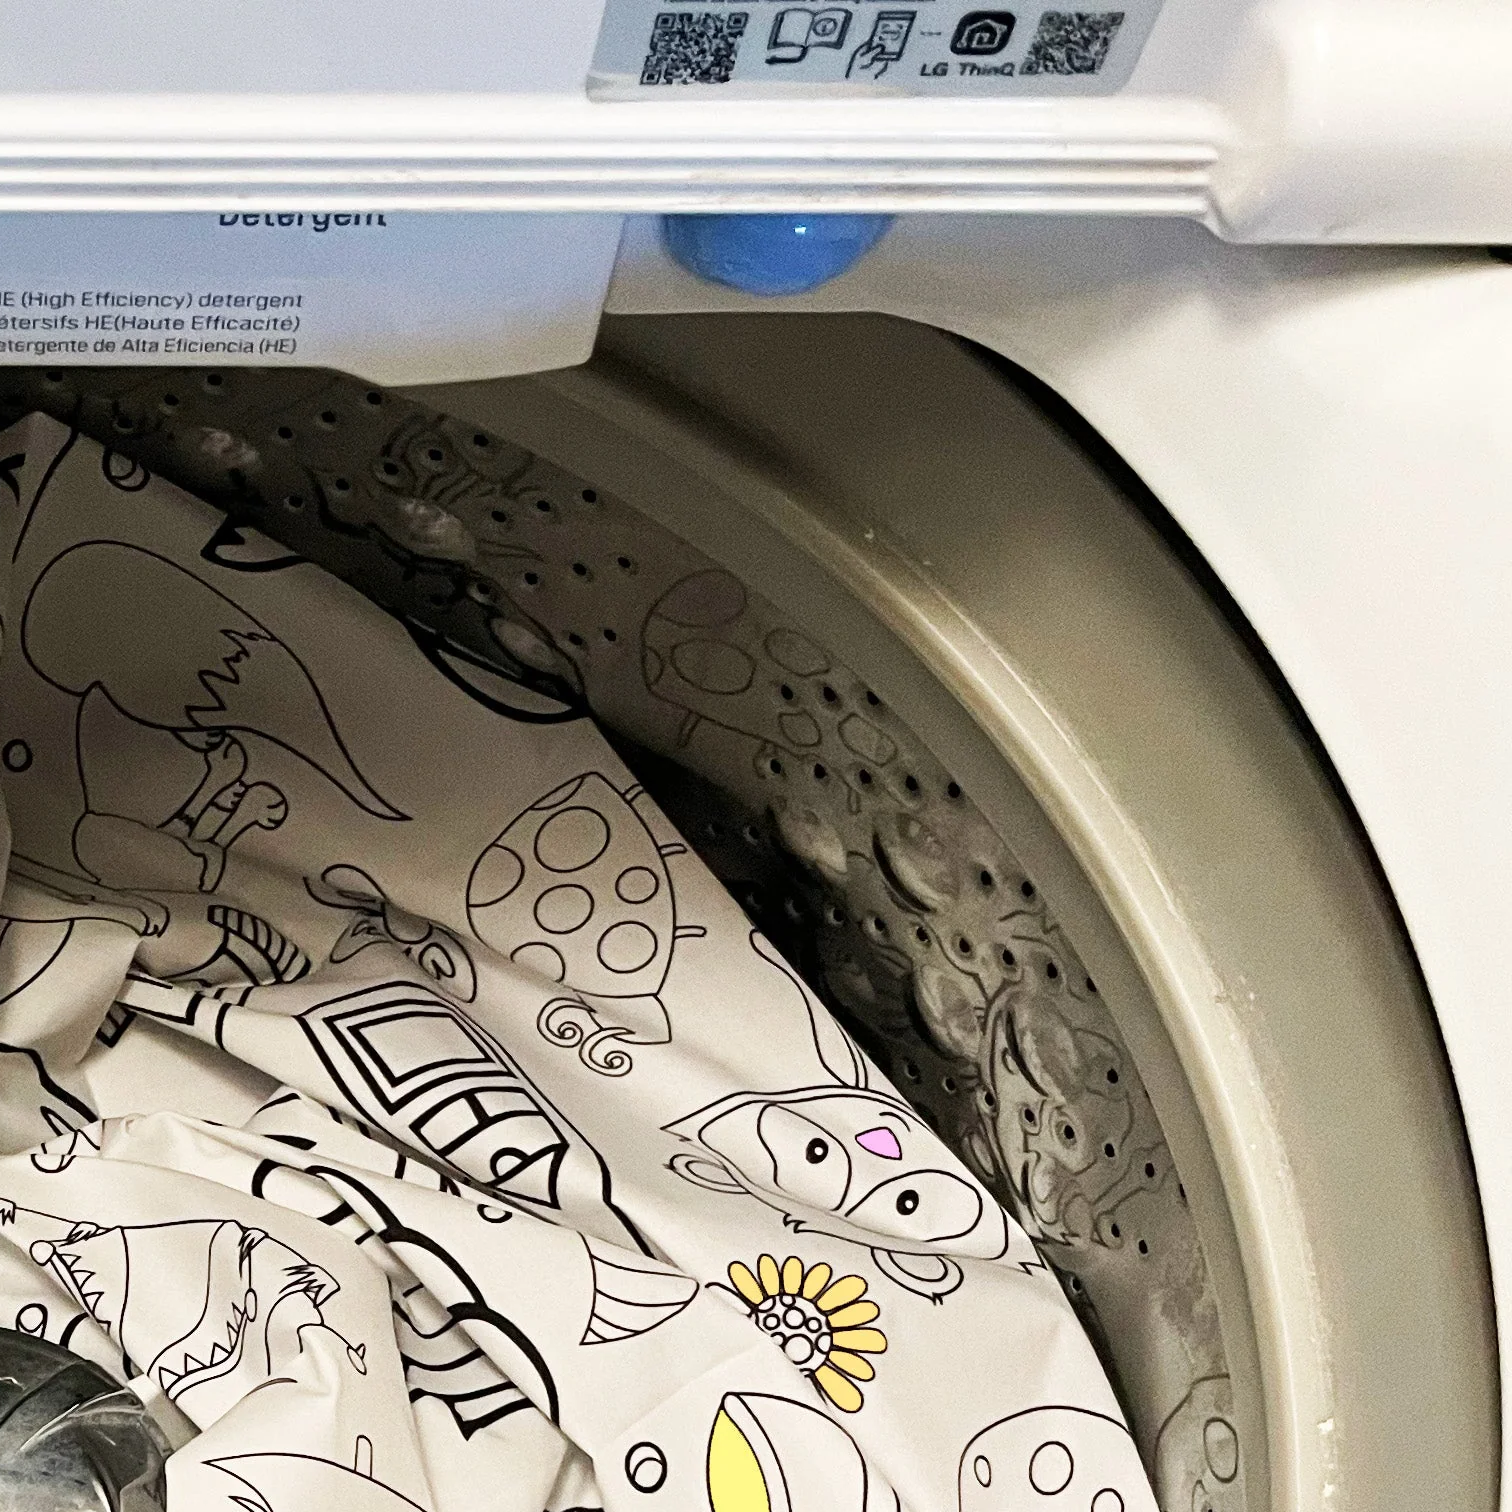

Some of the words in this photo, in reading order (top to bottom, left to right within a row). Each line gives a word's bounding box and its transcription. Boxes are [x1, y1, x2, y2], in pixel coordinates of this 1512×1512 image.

[920, 63, 948, 77] LG
[959, 63, 1014, 77] ThinQ
[21, 291, 75, 310] (High
[81, 291, 192, 310] Efficiency)
[198, 292, 303, 311] detergent
[191, 314, 300, 333] Efficacité)
[93, 338, 116, 353] de
[122, 338, 159, 353] Alta
[164, 338, 255, 353] Eficiencia
[259, 338, 297, 354] (HE)
